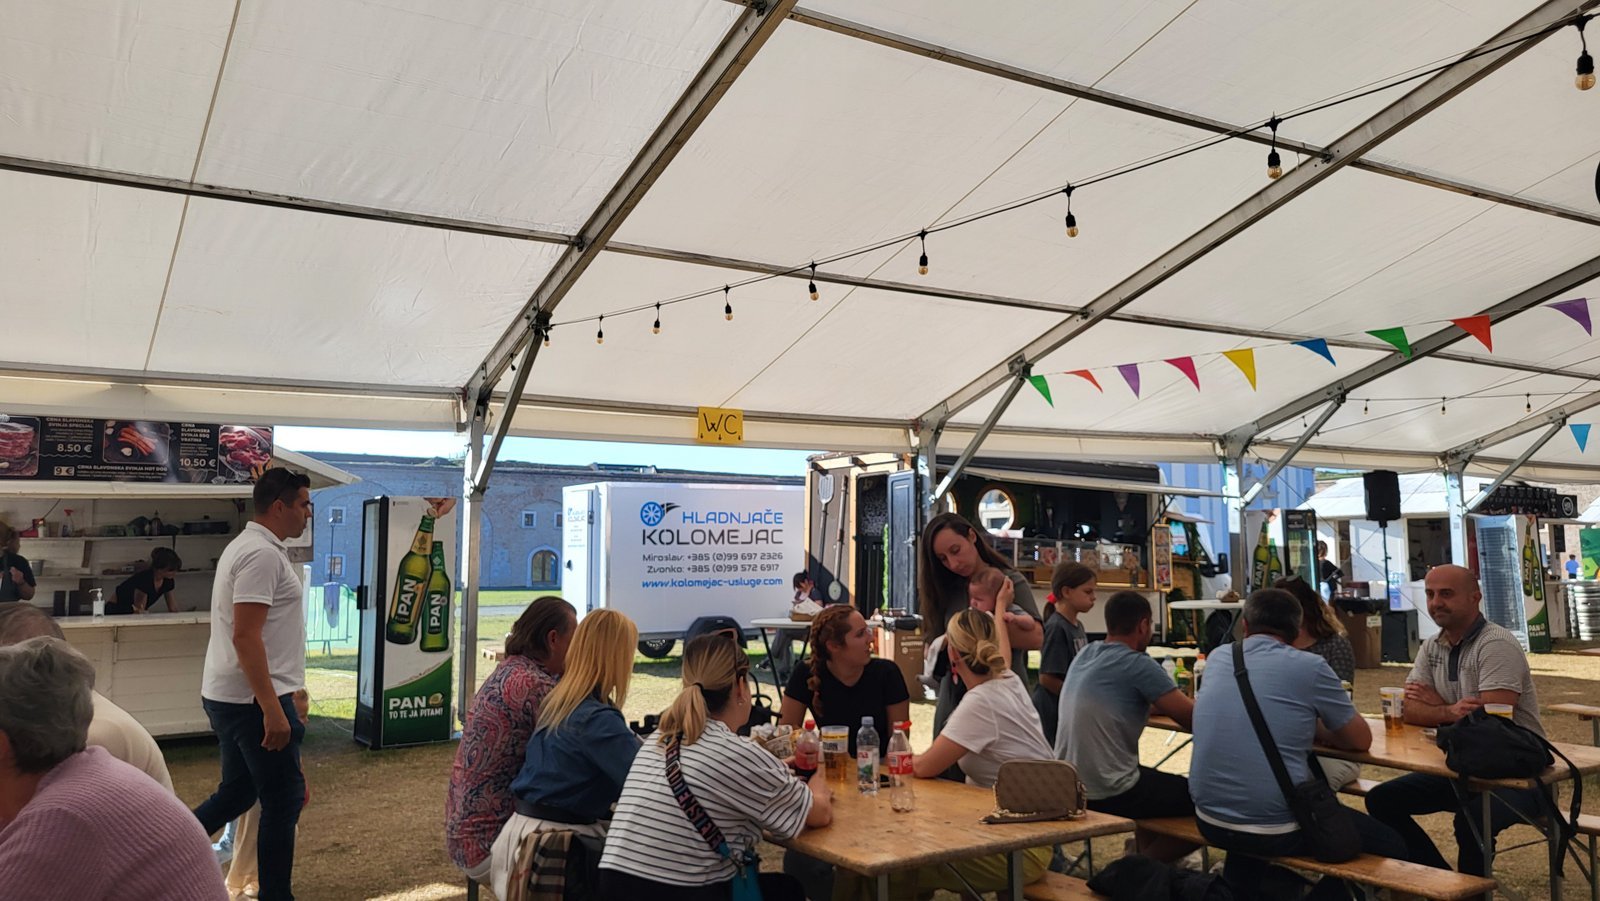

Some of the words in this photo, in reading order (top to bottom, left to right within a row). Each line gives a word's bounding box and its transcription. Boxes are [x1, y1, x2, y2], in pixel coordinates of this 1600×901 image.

[703, 412, 738, 435] WC
[57, 443, 81, 453] 8.50
[83, 444, 92, 453] €
[180, 458, 206, 467] 10.50
[55, 466, 62, 475] 9
[682, 509, 783, 524] HLADNJAČE
[642, 529, 783, 545] KOLOMEJAC
[642, 553, 685, 561] Miroslav:
[687, 553, 710, 561] +385
[712, 552, 738, 562] (0)99
[741, 553, 758, 561] 697
[760, 552, 783, 560] 2326
[687, 564, 710, 573] +385
[712, 564, 738, 573] (0)99
[741, 564, 758, 572] 572
[642, 577, 783, 589] www.kolomejac-usluge.com
[397, 578, 417, 616] PAN
[430, 593, 441, 627] PAN
[389, 696, 427, 710] PAN
[389, 711, 398, 720] TO
[400, 710, 407, 719] TE
[409, 709, 418, 718] JA
[420, 708, 443, 717] PITAM!
